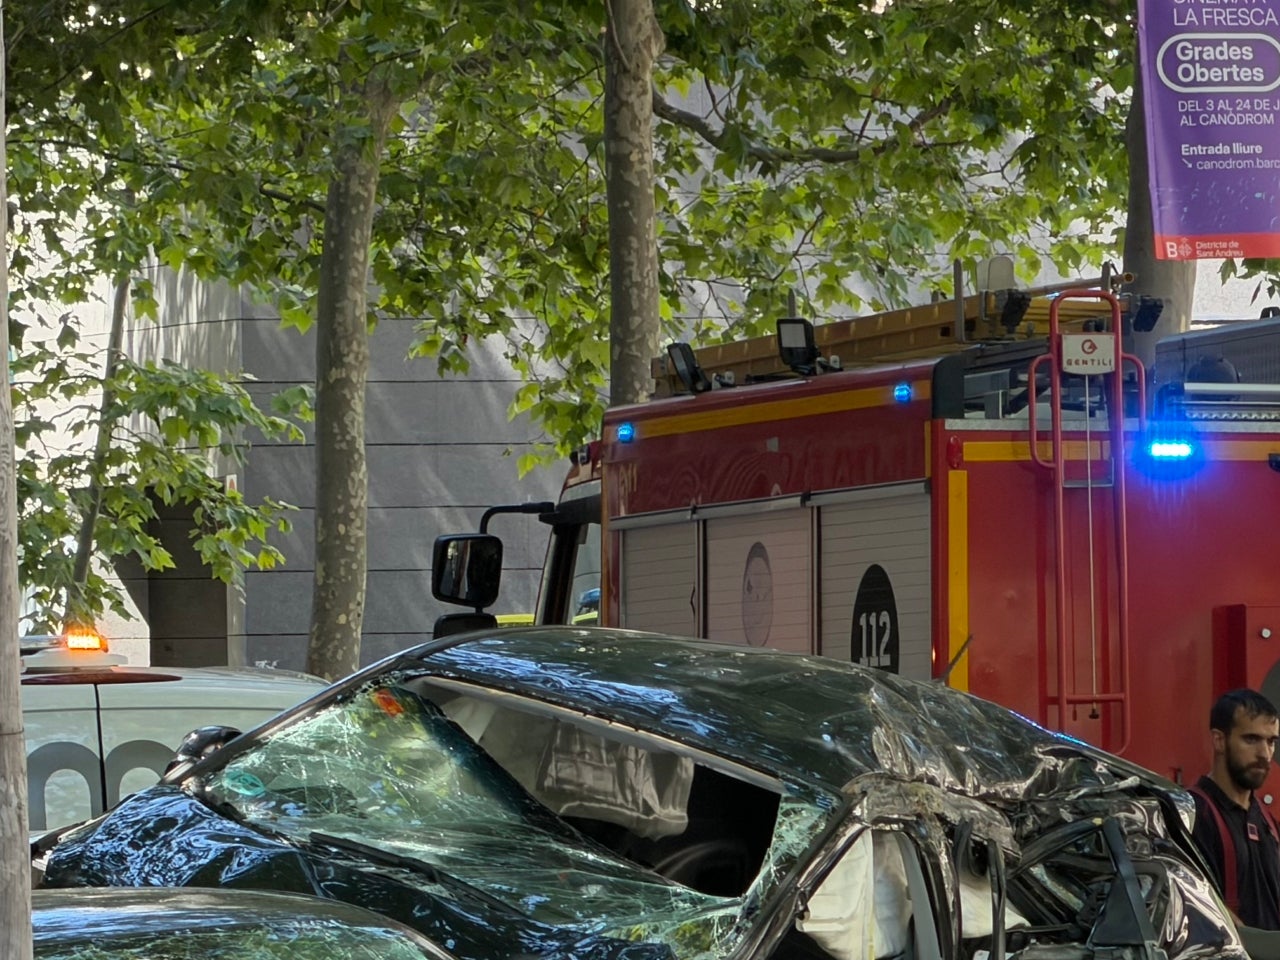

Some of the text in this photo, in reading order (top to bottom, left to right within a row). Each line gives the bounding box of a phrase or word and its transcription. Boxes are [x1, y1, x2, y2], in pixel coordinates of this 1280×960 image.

[1173, 8, 1279, 26] LA FRESCA
[1176, 41, 1254, 61] Grades
[1177, 63, 1265, 83] Obertes
[1178, 100, 1203, 112] DEL
[1206, 100, 1214, 111] 3
[1217, 100, 1232, 111] AL
[1236, 99, 1251, 111] 24
[1254, 99, 1270, 110] DE
[1180, 115, 1196, 127] AL
[1181, 142, 1263, 156] Entrada lliure
[1066, 358, 1112, 367] GENTILI
[859, 610, 891, 667] 112
